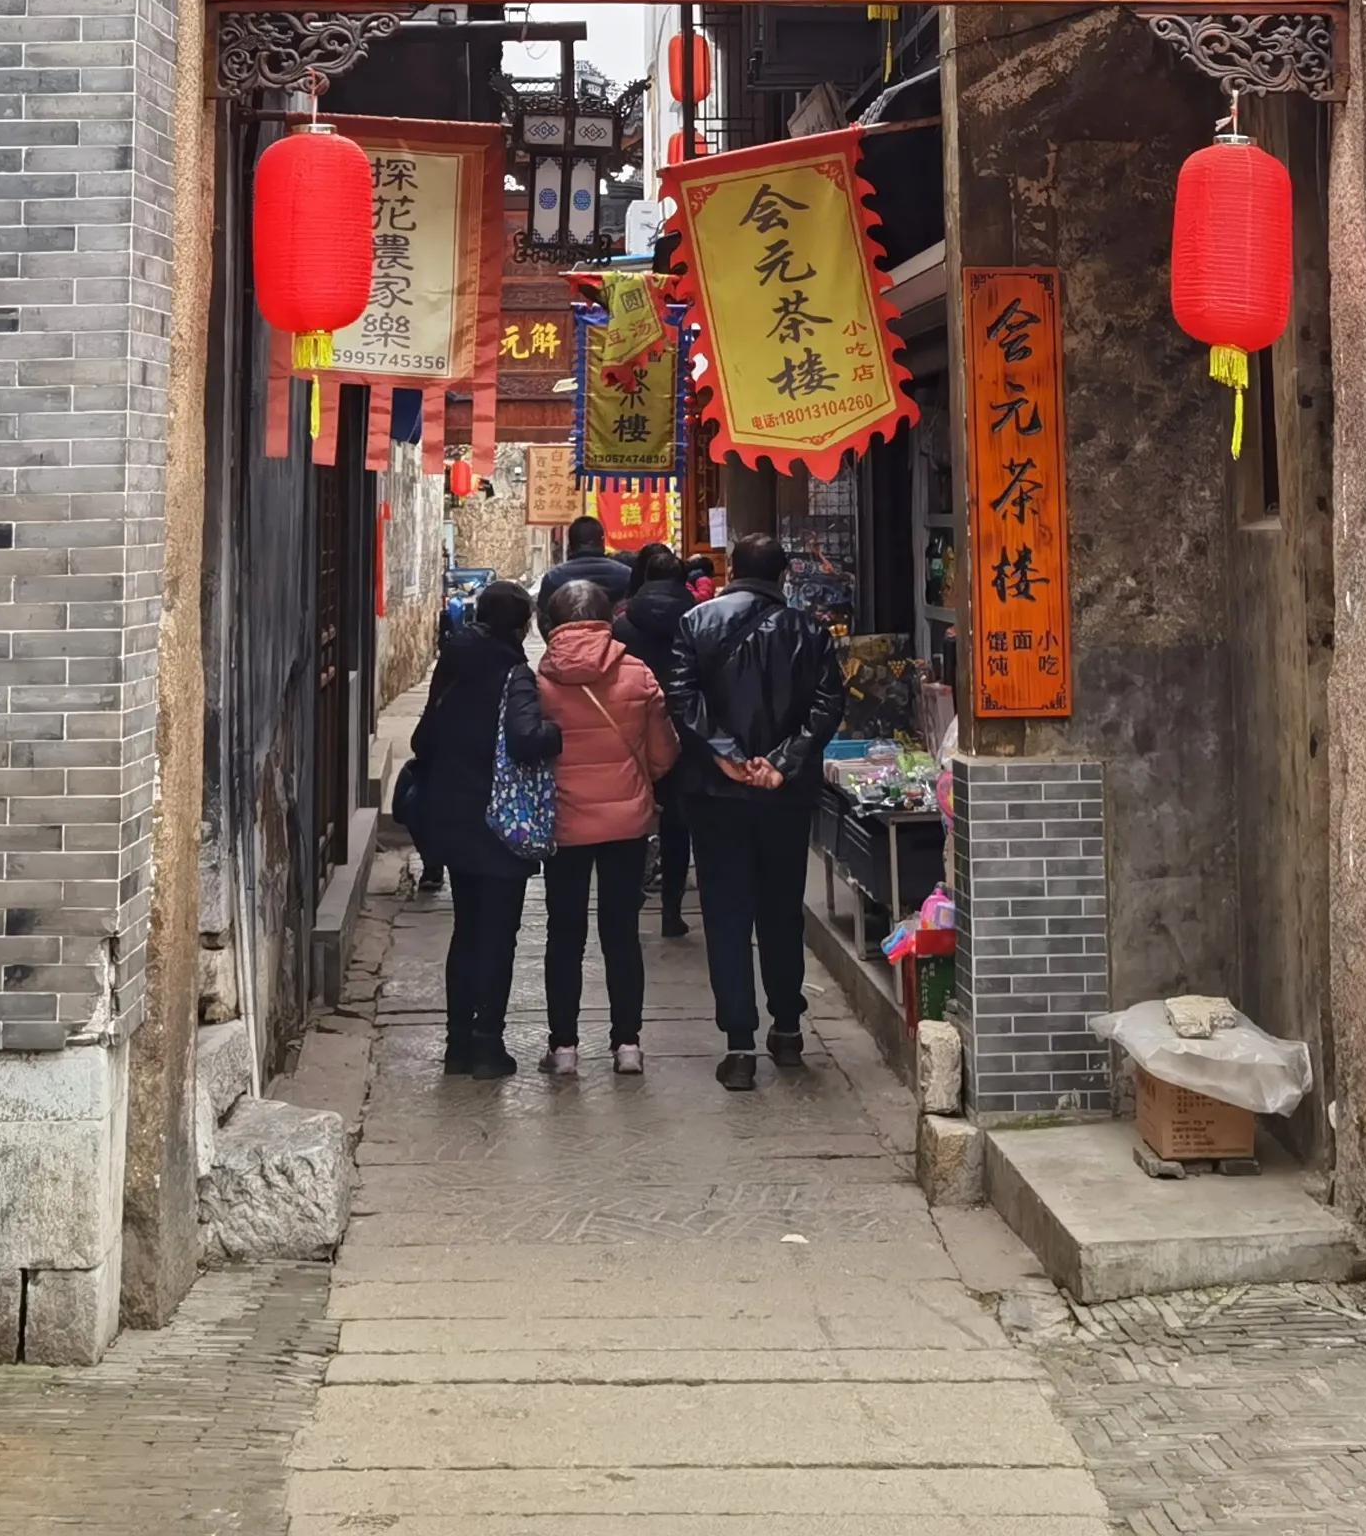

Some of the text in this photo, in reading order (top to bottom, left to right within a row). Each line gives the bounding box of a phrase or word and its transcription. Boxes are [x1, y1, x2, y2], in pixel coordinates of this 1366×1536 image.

[738, 183, 840, 402] 会元茶楼
[331, 349, 447, 371] 5995745356
[842, 319, 875, 383] 小吃店
[986, 297, 1050, 603] 会元茶楼
[1012, 630, 1033, 651] 面
[1037, 629, 1060, 677] 小吃
